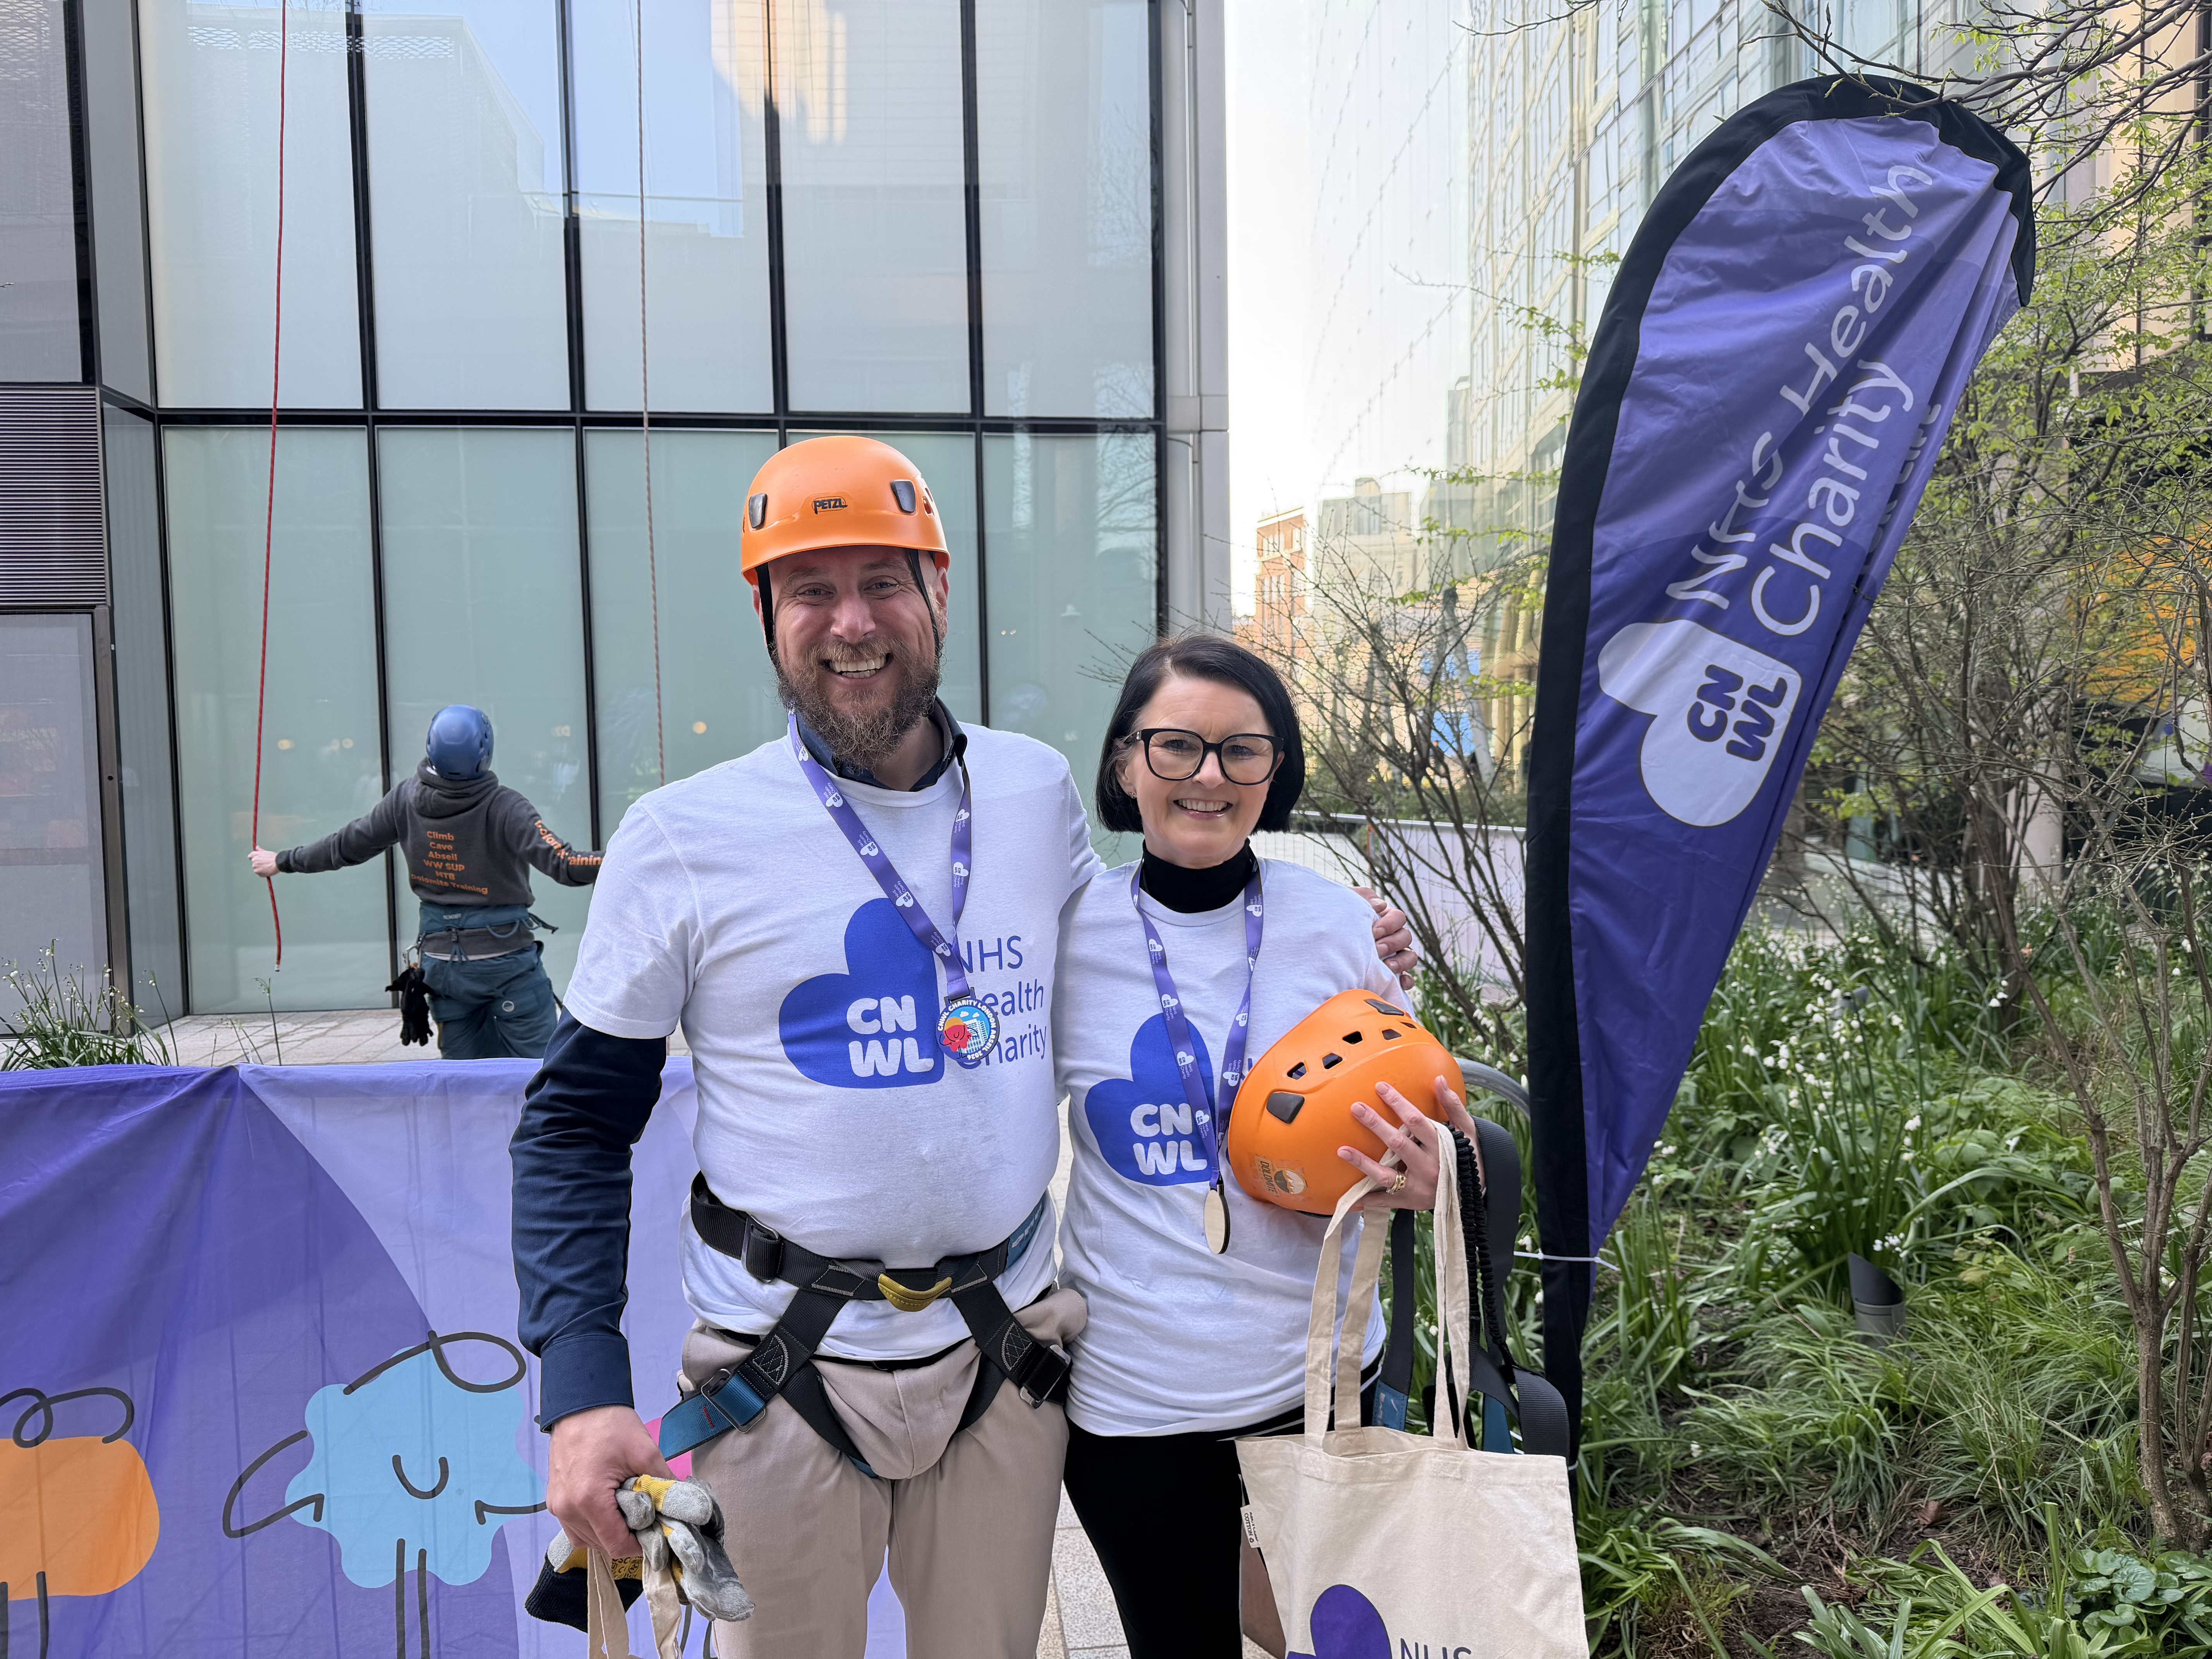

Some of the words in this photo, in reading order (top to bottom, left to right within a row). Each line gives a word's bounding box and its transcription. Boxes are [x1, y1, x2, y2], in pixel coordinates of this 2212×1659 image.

[1666, 431, 1783, 610] NHS
[1780, 165, 1933, 422] Health
[813, 498, 848, 514] PETZL
[1751, 358, 1915, 635] Charity
[1687, 664, 1743, 743] CN
[1726, 677, 1788, 762] WL
[427, 831, 454, 841] Climb
[430, 842, 453, 850] Cave
[423, 859, 443, 869] WW
[445, 863, 465, 871] SUP
[428, 851, 458, 861] Abseil
[411, 874, 449, 886] Dolomite
[451, 882, 488, 895] Training
[435, 871, 455, 880] MTB
[948, 1000, 977, 1012] CHARITY
[982, 979, 1044, 1016] ealth
[847, 995, 916, 1034] CN
[938, 1012, 949, 1031] CNWL
[977, 1002, 996, 1028] LONDON
[848, 1037, 934, 1077] WL
[957, 1024, 1046, 1069] arity
[967, 1050, 983, 1060] 2026
[1130, 1103, 1192, 1137] CN
[1133, 1140, 1207, 1175] WL
[1260, 1161, 1277, 1194] DOLOMITE
[1244, 1513, 1253, 1535] COTTON
